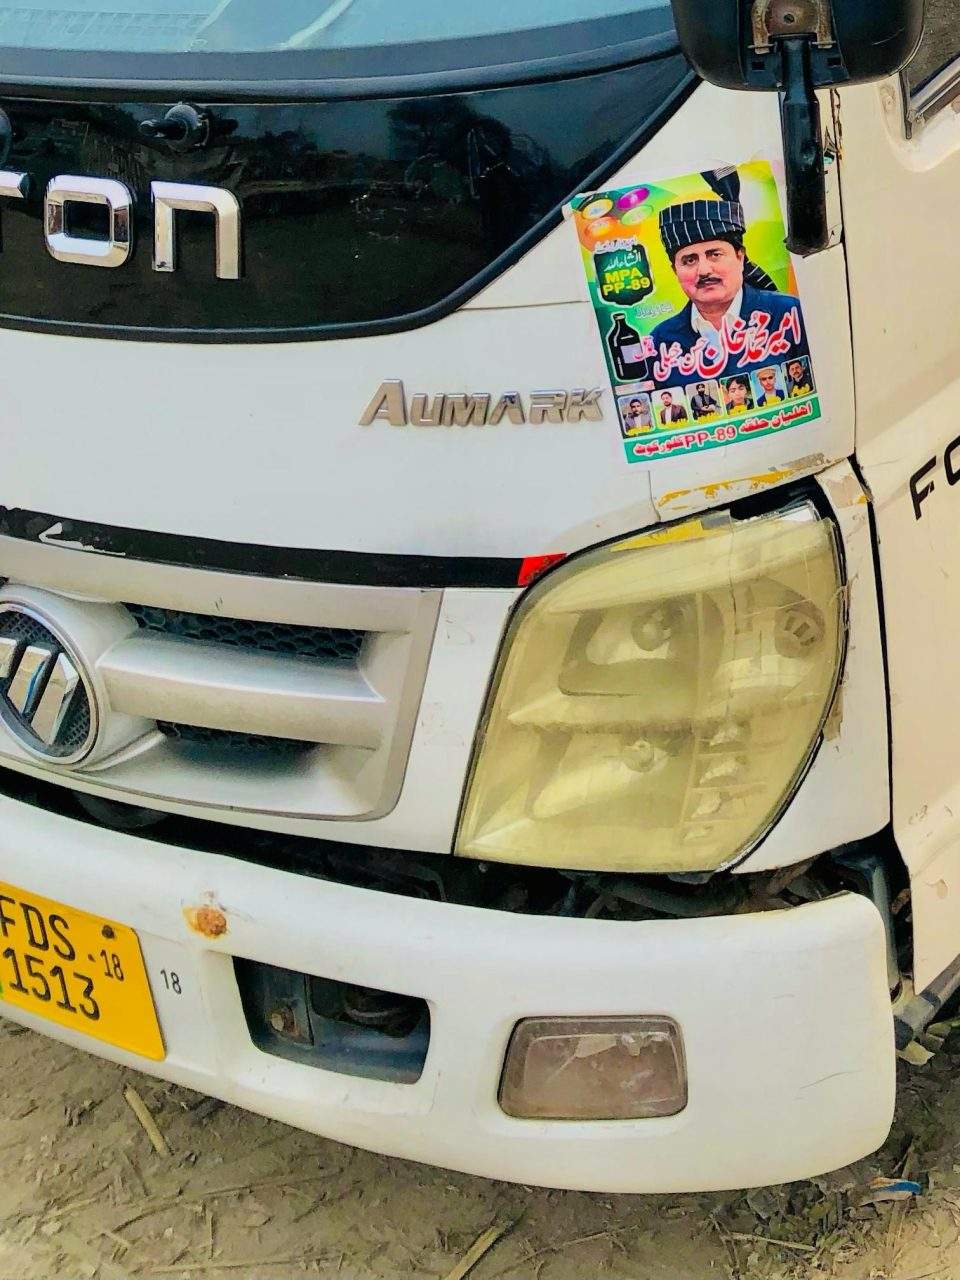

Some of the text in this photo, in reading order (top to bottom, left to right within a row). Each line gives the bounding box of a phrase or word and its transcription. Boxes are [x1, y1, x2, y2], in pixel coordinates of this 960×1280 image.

[602, 276, 652, 296] PP-89
[604, 267, 644, 284] MPA
[683, 424, 737, 449] PP-89
[0, 894, 76, 962] FDS
[3, 946, 125, 1021] 1513 18
[160, 968, 182, 995] 18
